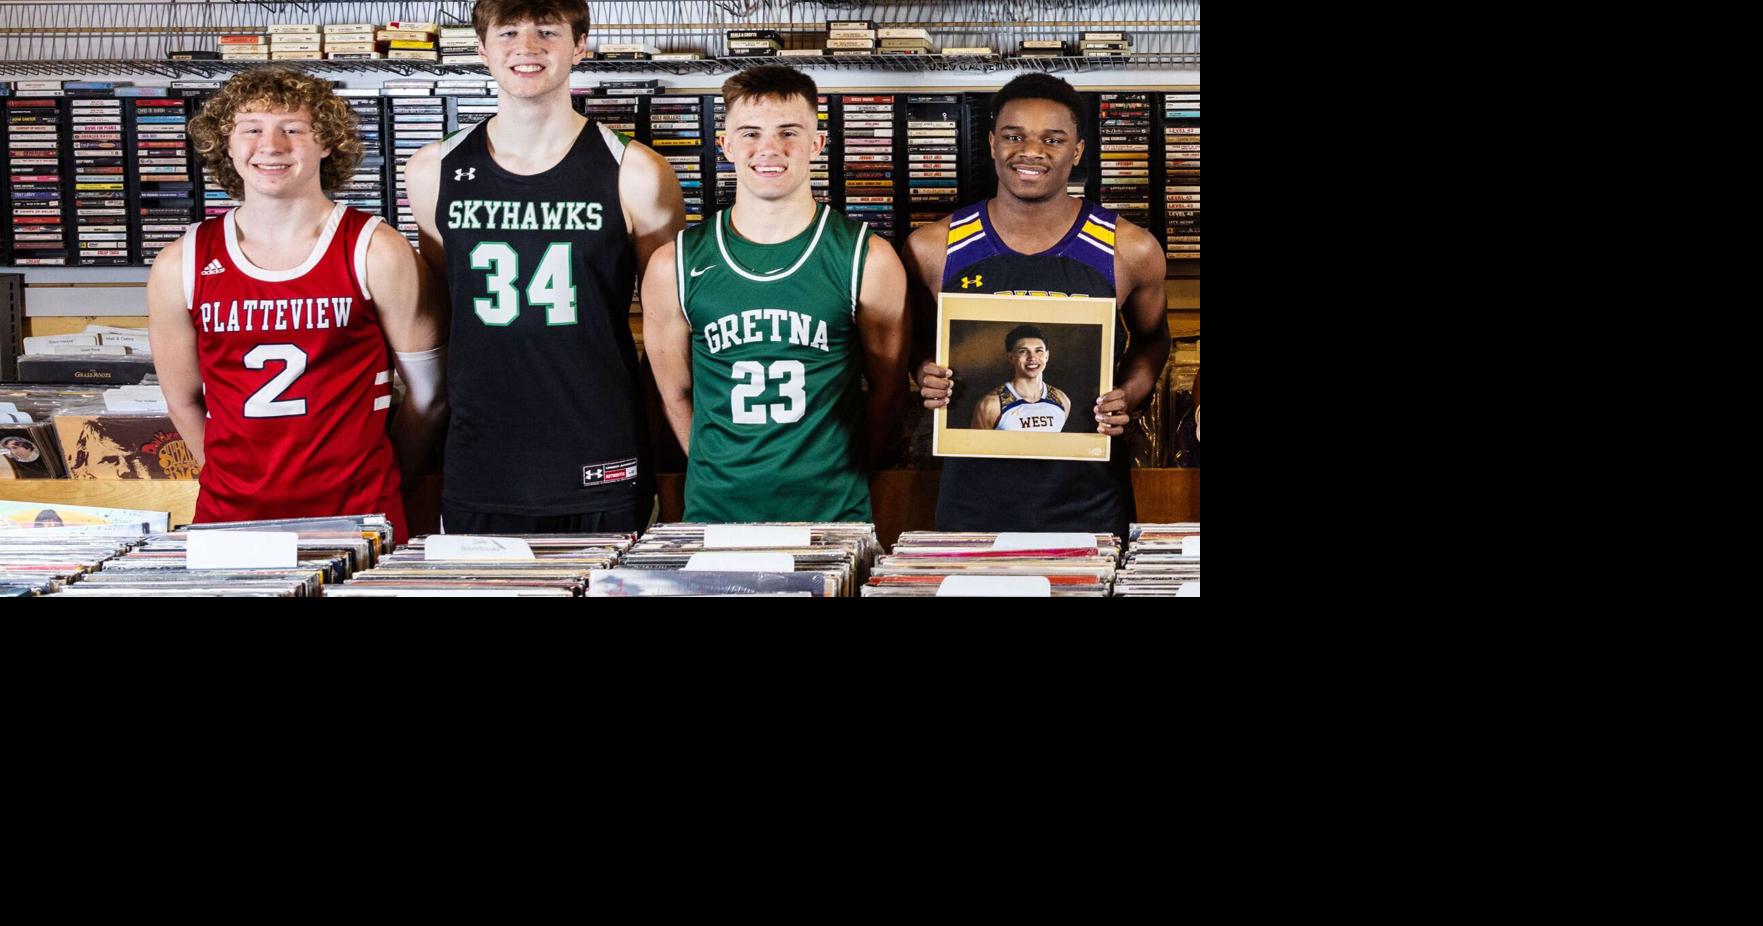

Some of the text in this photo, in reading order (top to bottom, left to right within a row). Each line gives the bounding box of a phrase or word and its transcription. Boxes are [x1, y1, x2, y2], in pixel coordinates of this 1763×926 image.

[448, 200, 603, 231] SKYHAWKS
[469, 241, 578, 326] 34
[200, 297, 353, 333] PLATTEVIEW
[704, 309, 829, 354] GRETNA
[243, 343, 307, 418] 2
[731, 360, 806, 424] 23
[1019, 416, 1054, 428] WEST
